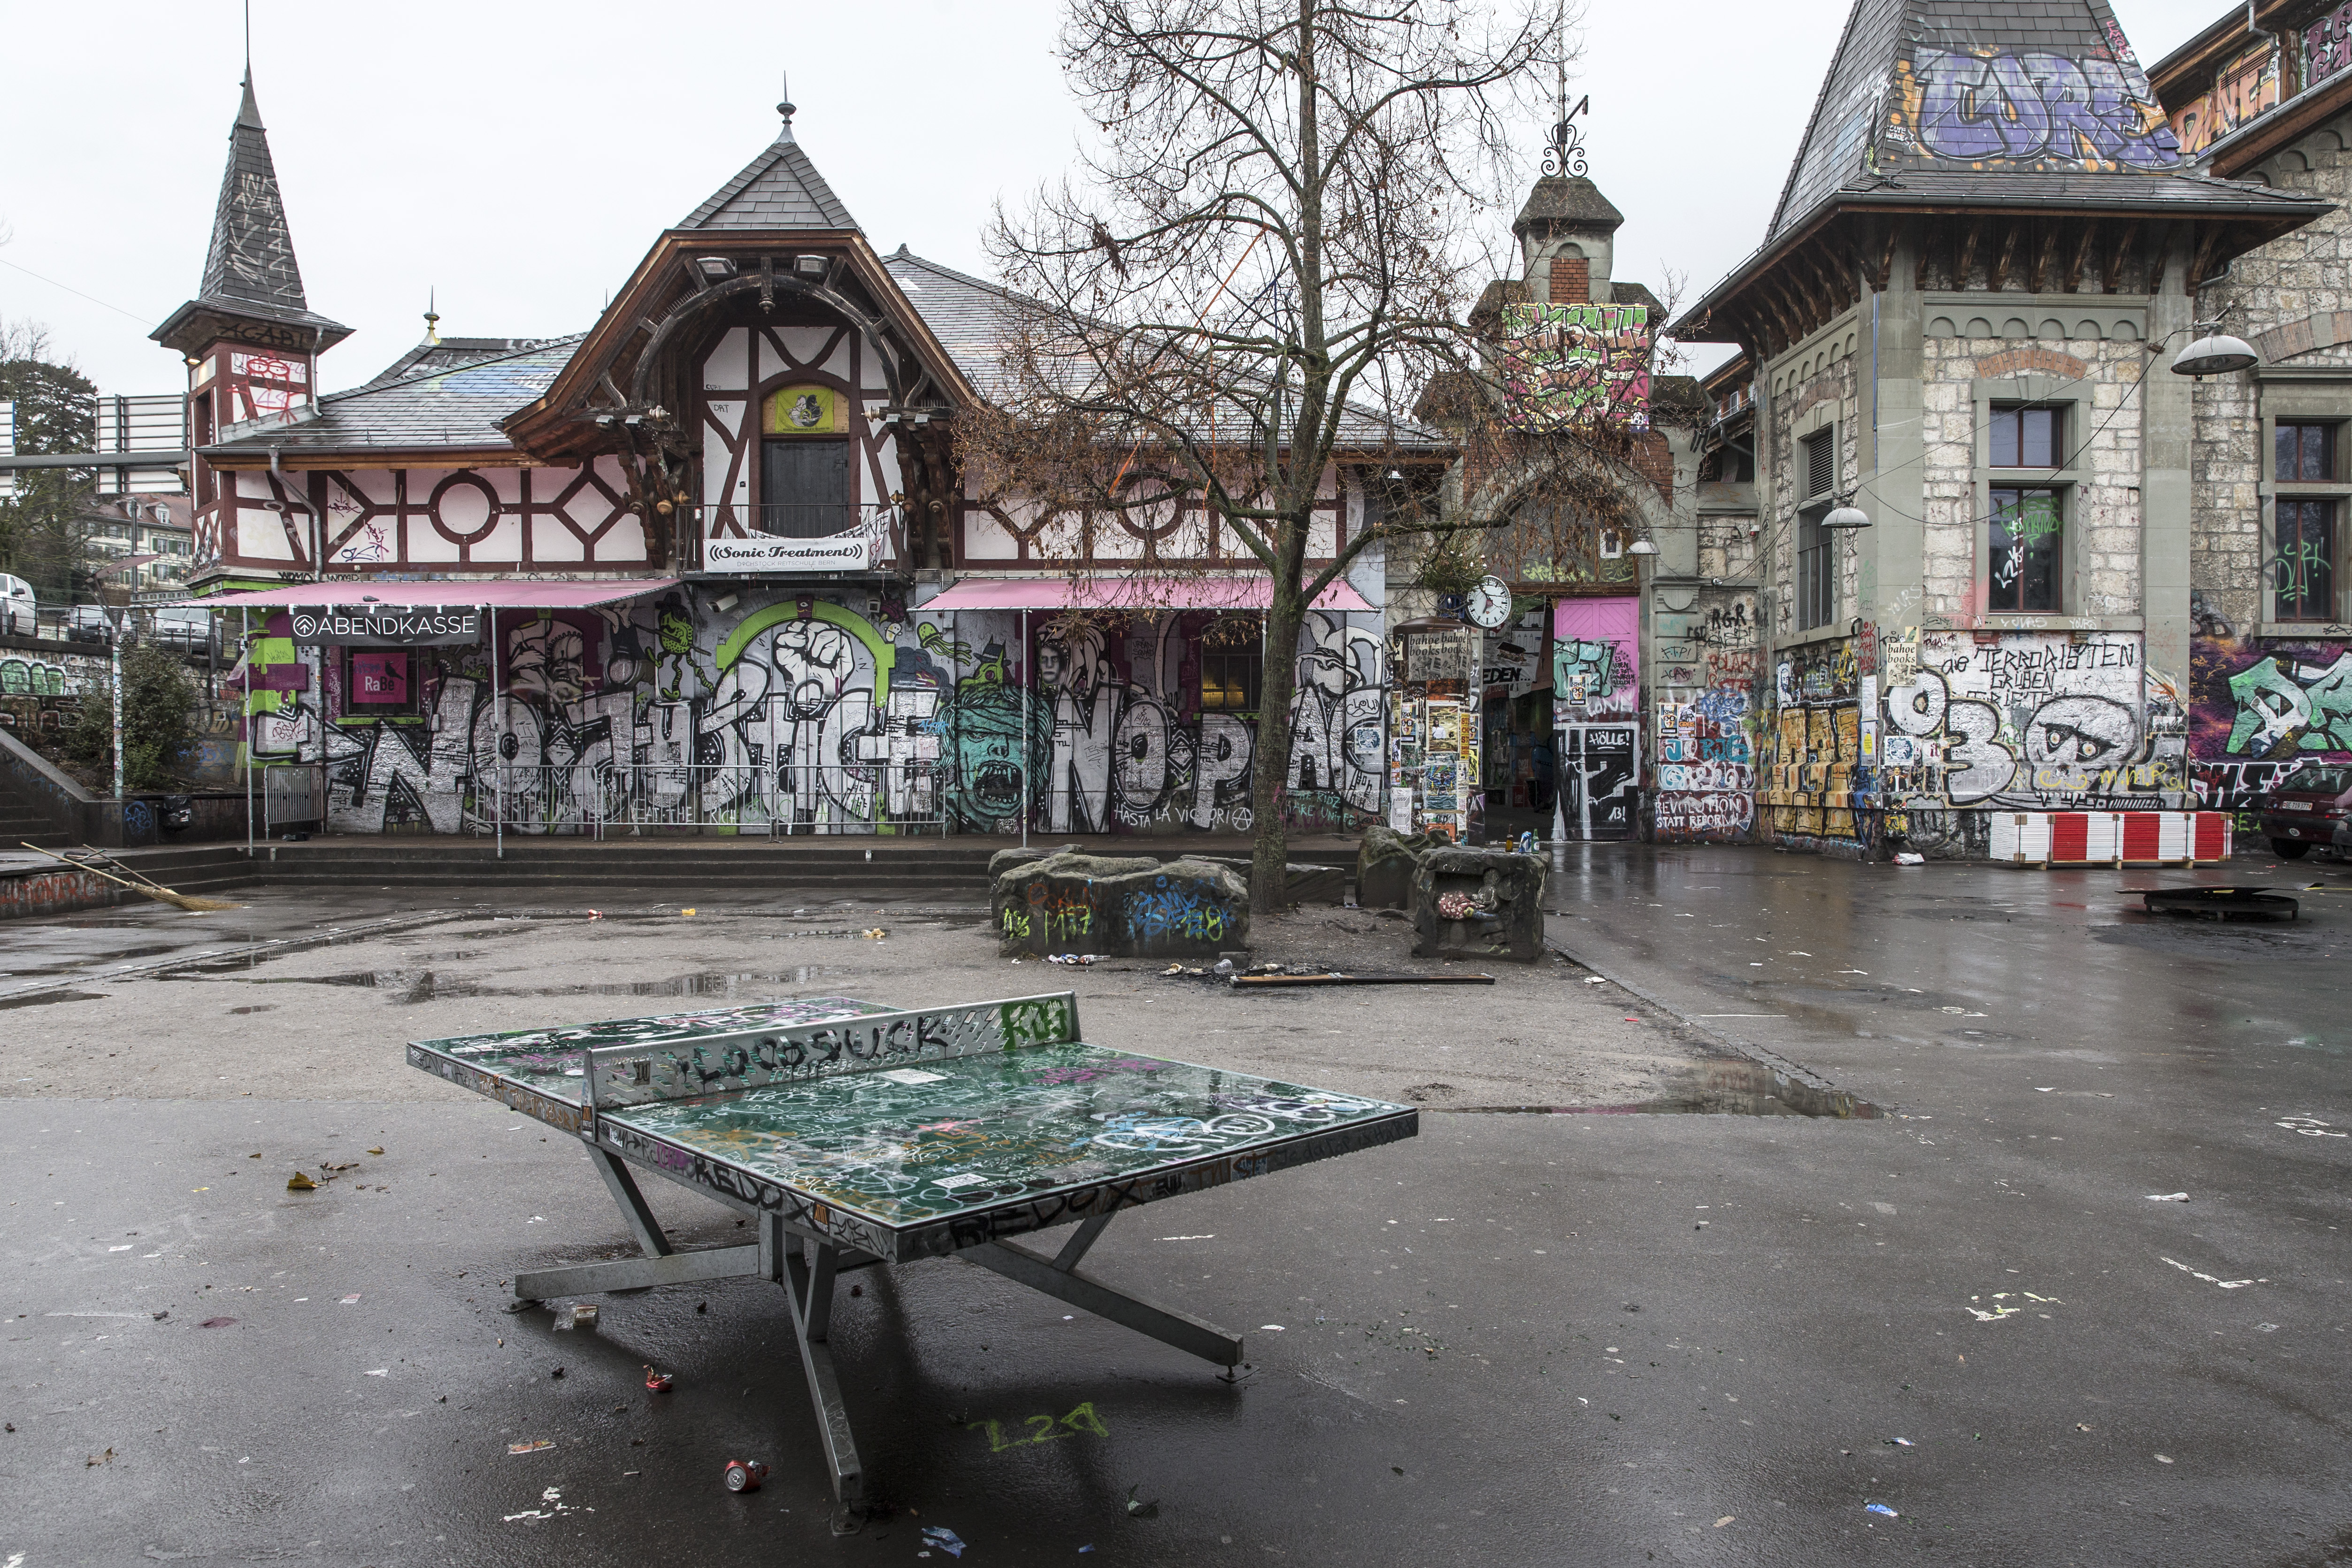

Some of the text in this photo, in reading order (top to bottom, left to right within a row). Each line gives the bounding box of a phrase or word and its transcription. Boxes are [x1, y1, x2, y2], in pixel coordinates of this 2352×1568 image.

[317, 615, 475, 635] ABENDKASSE
[1133, 640, 1154, 649] URBAN
[1410, 632, 1466, 646] bahoe bahoe
[1409, 643, 1466, 656] books books
[1888, 644, 1915, 653] bahoe
[1887, 653, 1916, 663] books
[365, 676, 394, 691] RaBe
[1589, 730, 1629, 746] HÖLLE!
[668, 807, 693, 823] THE
[709, 807, 736, 824] RICH
[1114, 803, 1152, 828] HASTA
[1156, 808, 1170, 822] LA
[1656, 816, 1685, 828] STATT
[999, 826, 1021, 834] BITCH!
[694, 1155, 816, 1230] REDOX
